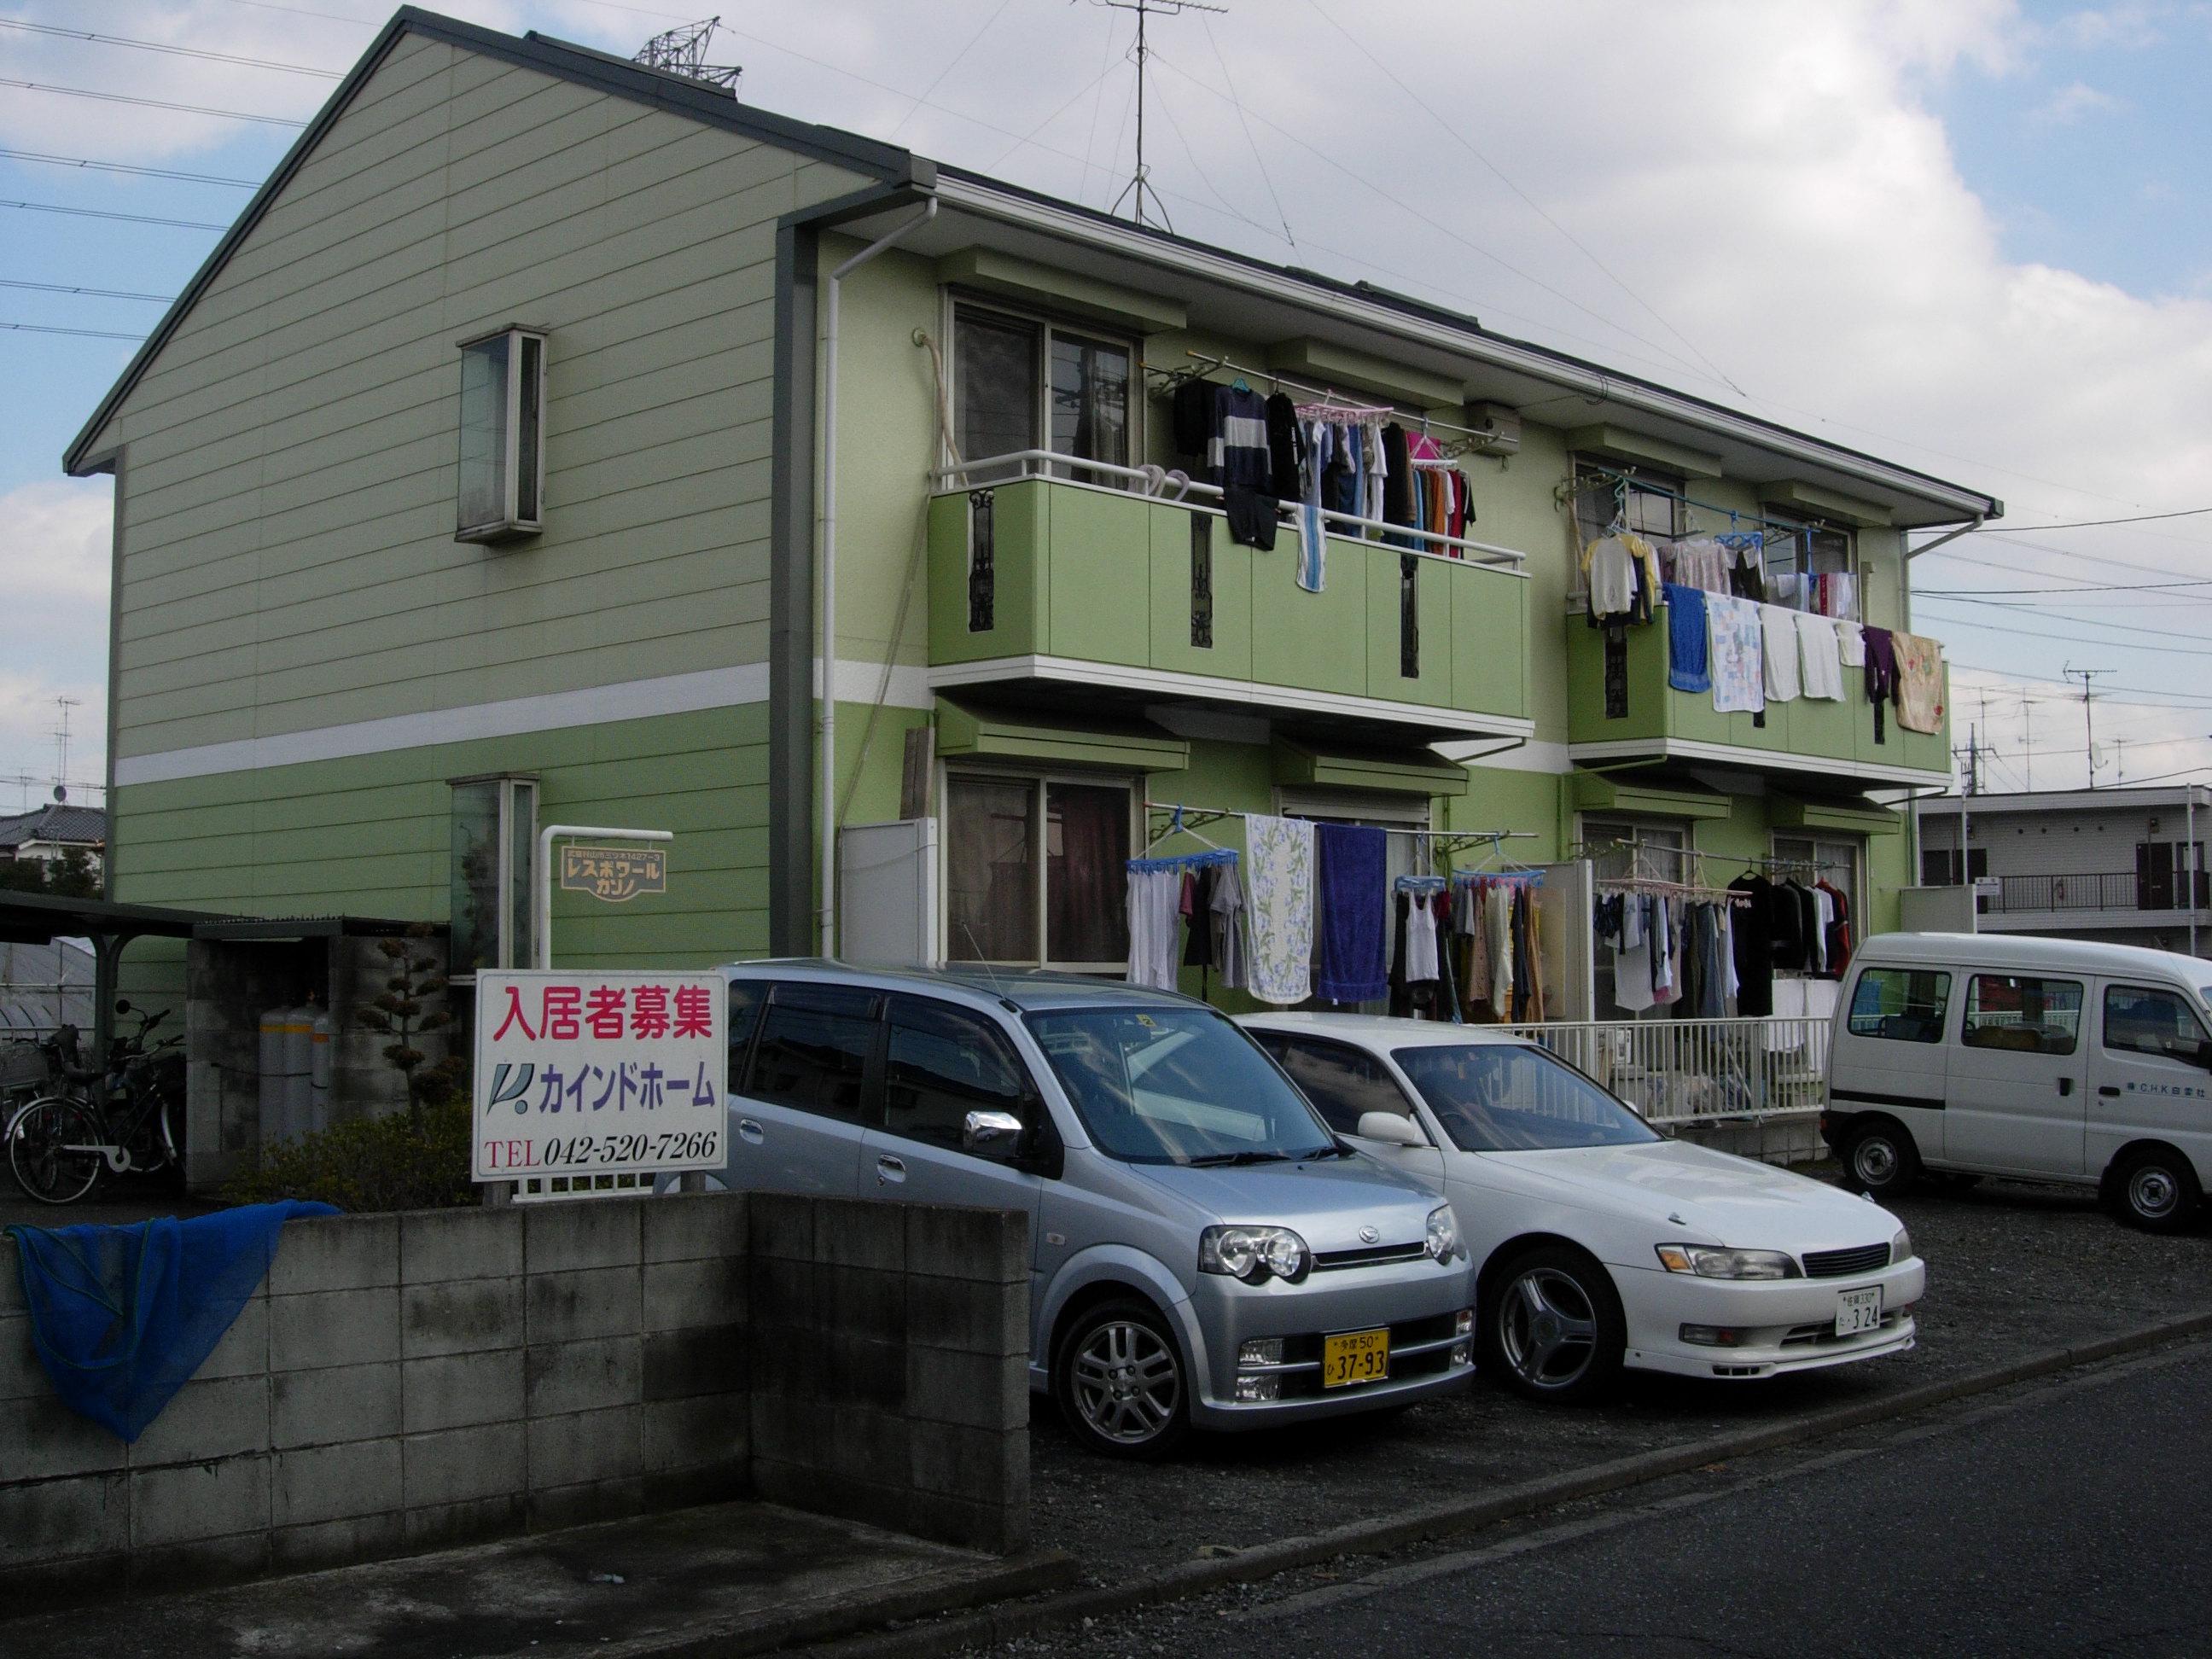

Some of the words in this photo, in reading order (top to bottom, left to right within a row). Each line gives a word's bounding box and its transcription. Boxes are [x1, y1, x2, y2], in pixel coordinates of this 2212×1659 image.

[492, 984, 713, 1041] 入居者募集
[538, 1061, 716, 1114] カインドホーム
[484, 1139, 541, 1168] TEL
[544, 1131, 718, 1167] 042-520-7266
[1337, 1350, 1384, 1380] 37-93
